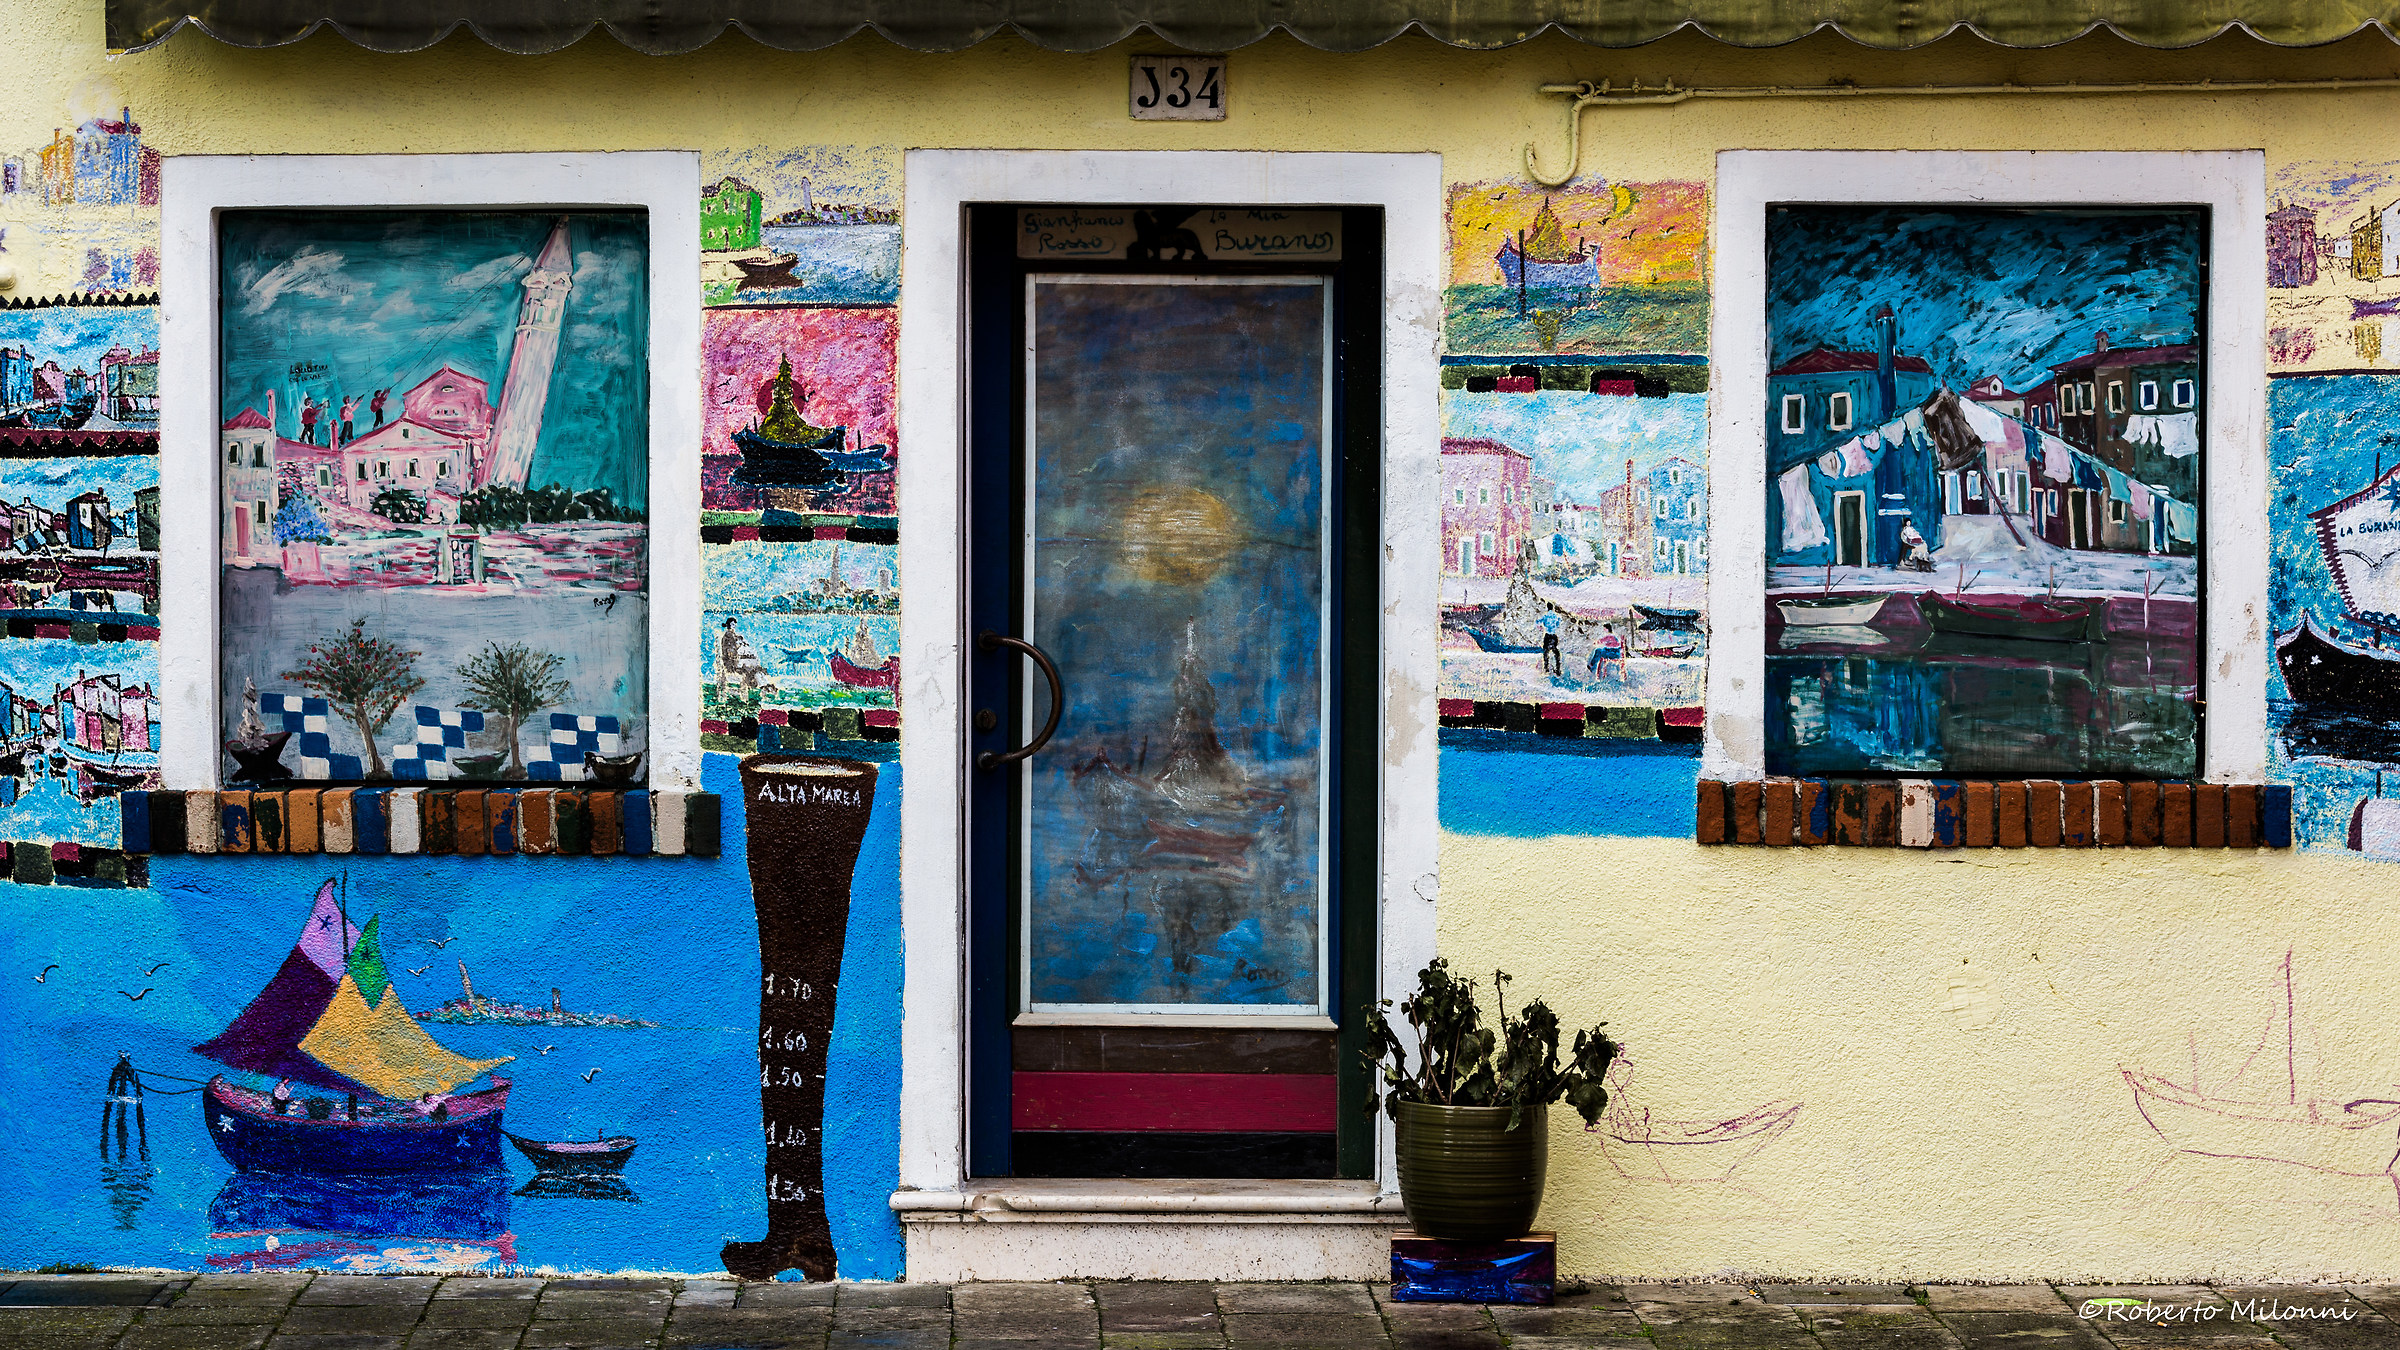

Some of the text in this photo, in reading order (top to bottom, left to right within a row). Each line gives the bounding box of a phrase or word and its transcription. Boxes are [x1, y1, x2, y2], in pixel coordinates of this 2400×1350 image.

[1024, 210, 1124, 234] Gianfranco
[1039, 232, 1110, 254] Rosso
[2340, 520, 2400, 538] LA BURAN
[758, 781, 862, 808] ALTA MAREA
[765, 973, 812, 1000] 1.70
[762, 1026, 808, 1052] 1.60
[760, 1064, 803, 1088] 1.50
[765, 1121, 807, 1147] 1.40
